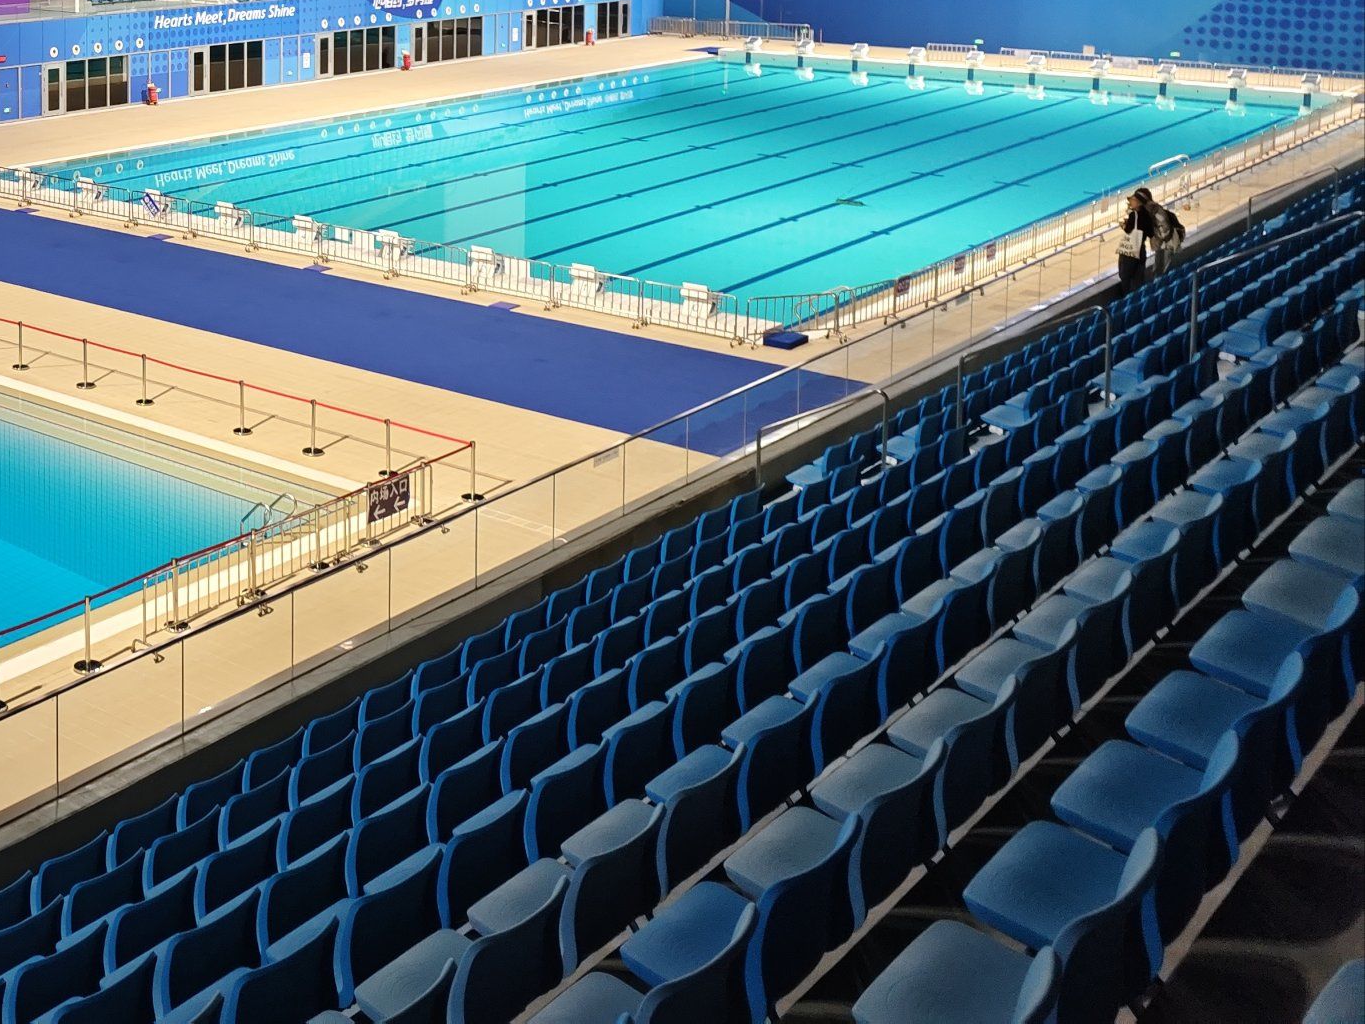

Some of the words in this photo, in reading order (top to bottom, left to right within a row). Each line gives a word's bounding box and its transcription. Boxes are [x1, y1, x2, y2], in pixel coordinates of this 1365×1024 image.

[154, 13, 192, 30] Hearts
[227, 7, 266, 22] Dreams
[268, 4, 296, 19] Shine
[370, 478, 408, 506] 内场入口
